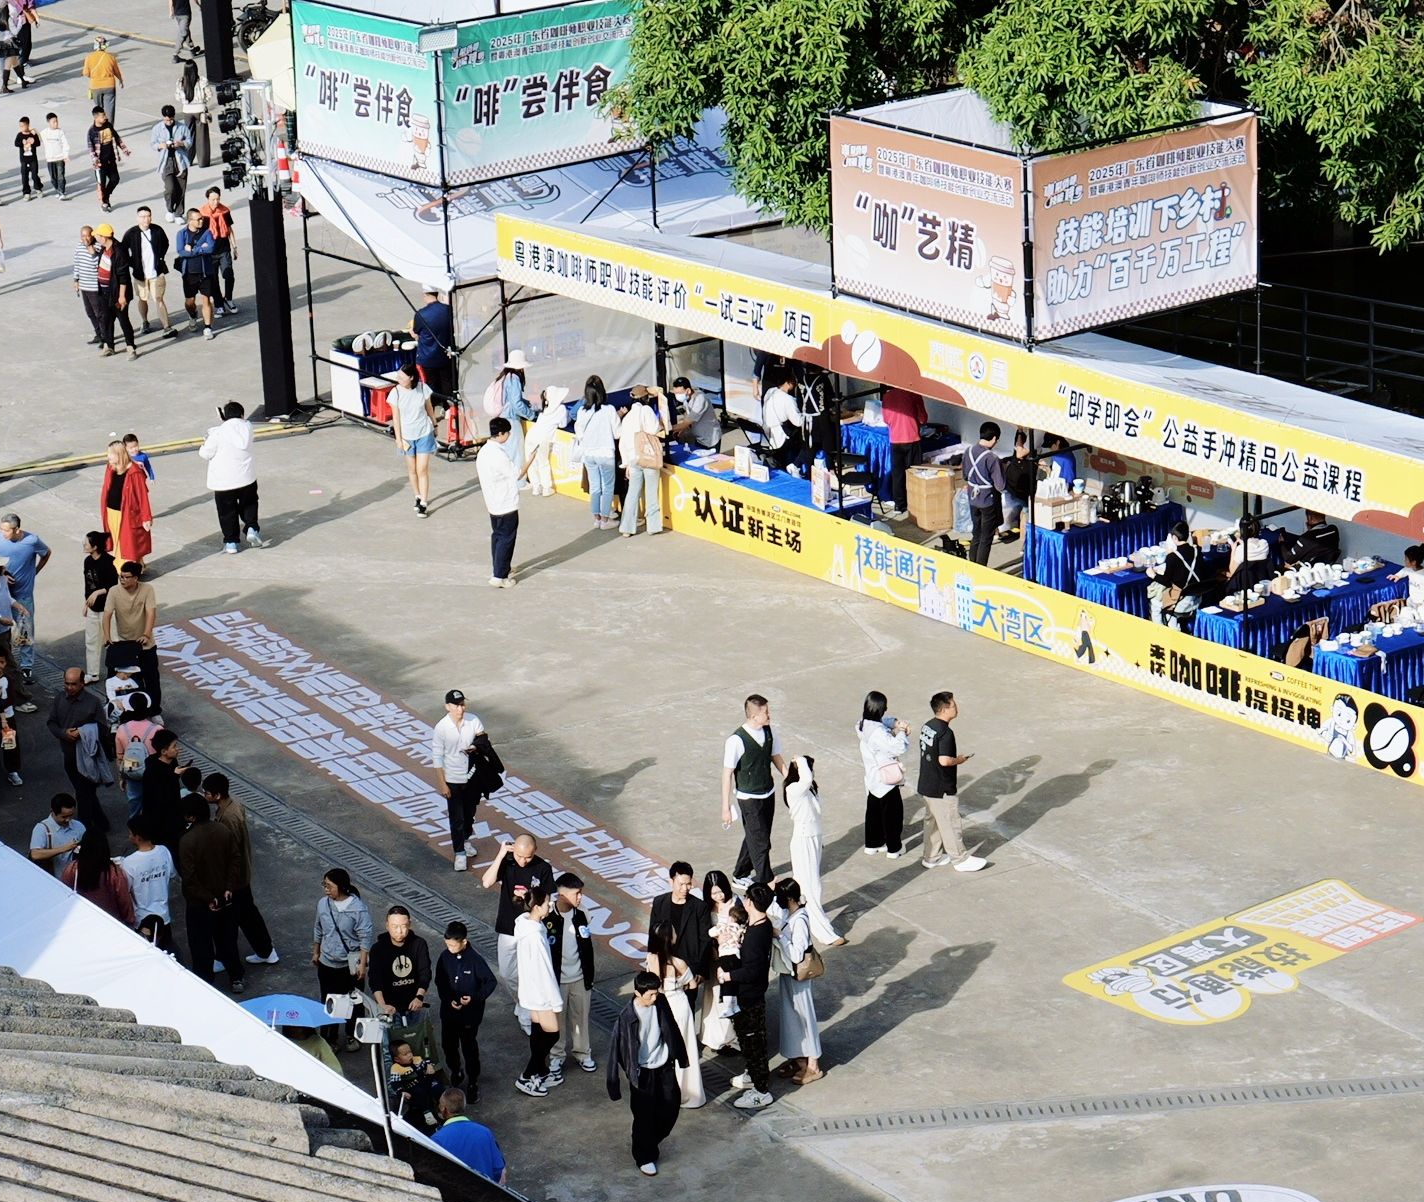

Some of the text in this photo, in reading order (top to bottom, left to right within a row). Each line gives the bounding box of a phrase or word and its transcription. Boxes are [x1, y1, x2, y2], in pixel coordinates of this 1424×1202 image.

[878, 147, 1013, 192] 2025年广东省咖啡师职业技能大赛
[1089, 136, 1245, 182] 2025年广东省咖啡师职业技能大赛
[856, 192, 975, 270] “咖”艺精
[1048, 224, 1245, 306] 助力“百千万工程”
[854, 532, 937, 586] 技能通行
[971, 599, 1051, 651] 大湾区
[1170, 649, 1241, 702] 咖啡
[1245, 687, 1321, 729] 提提神
[1140, 927, 1252, 976] 大湾区
[1149, 942, 1312, 1010] 技能通行
